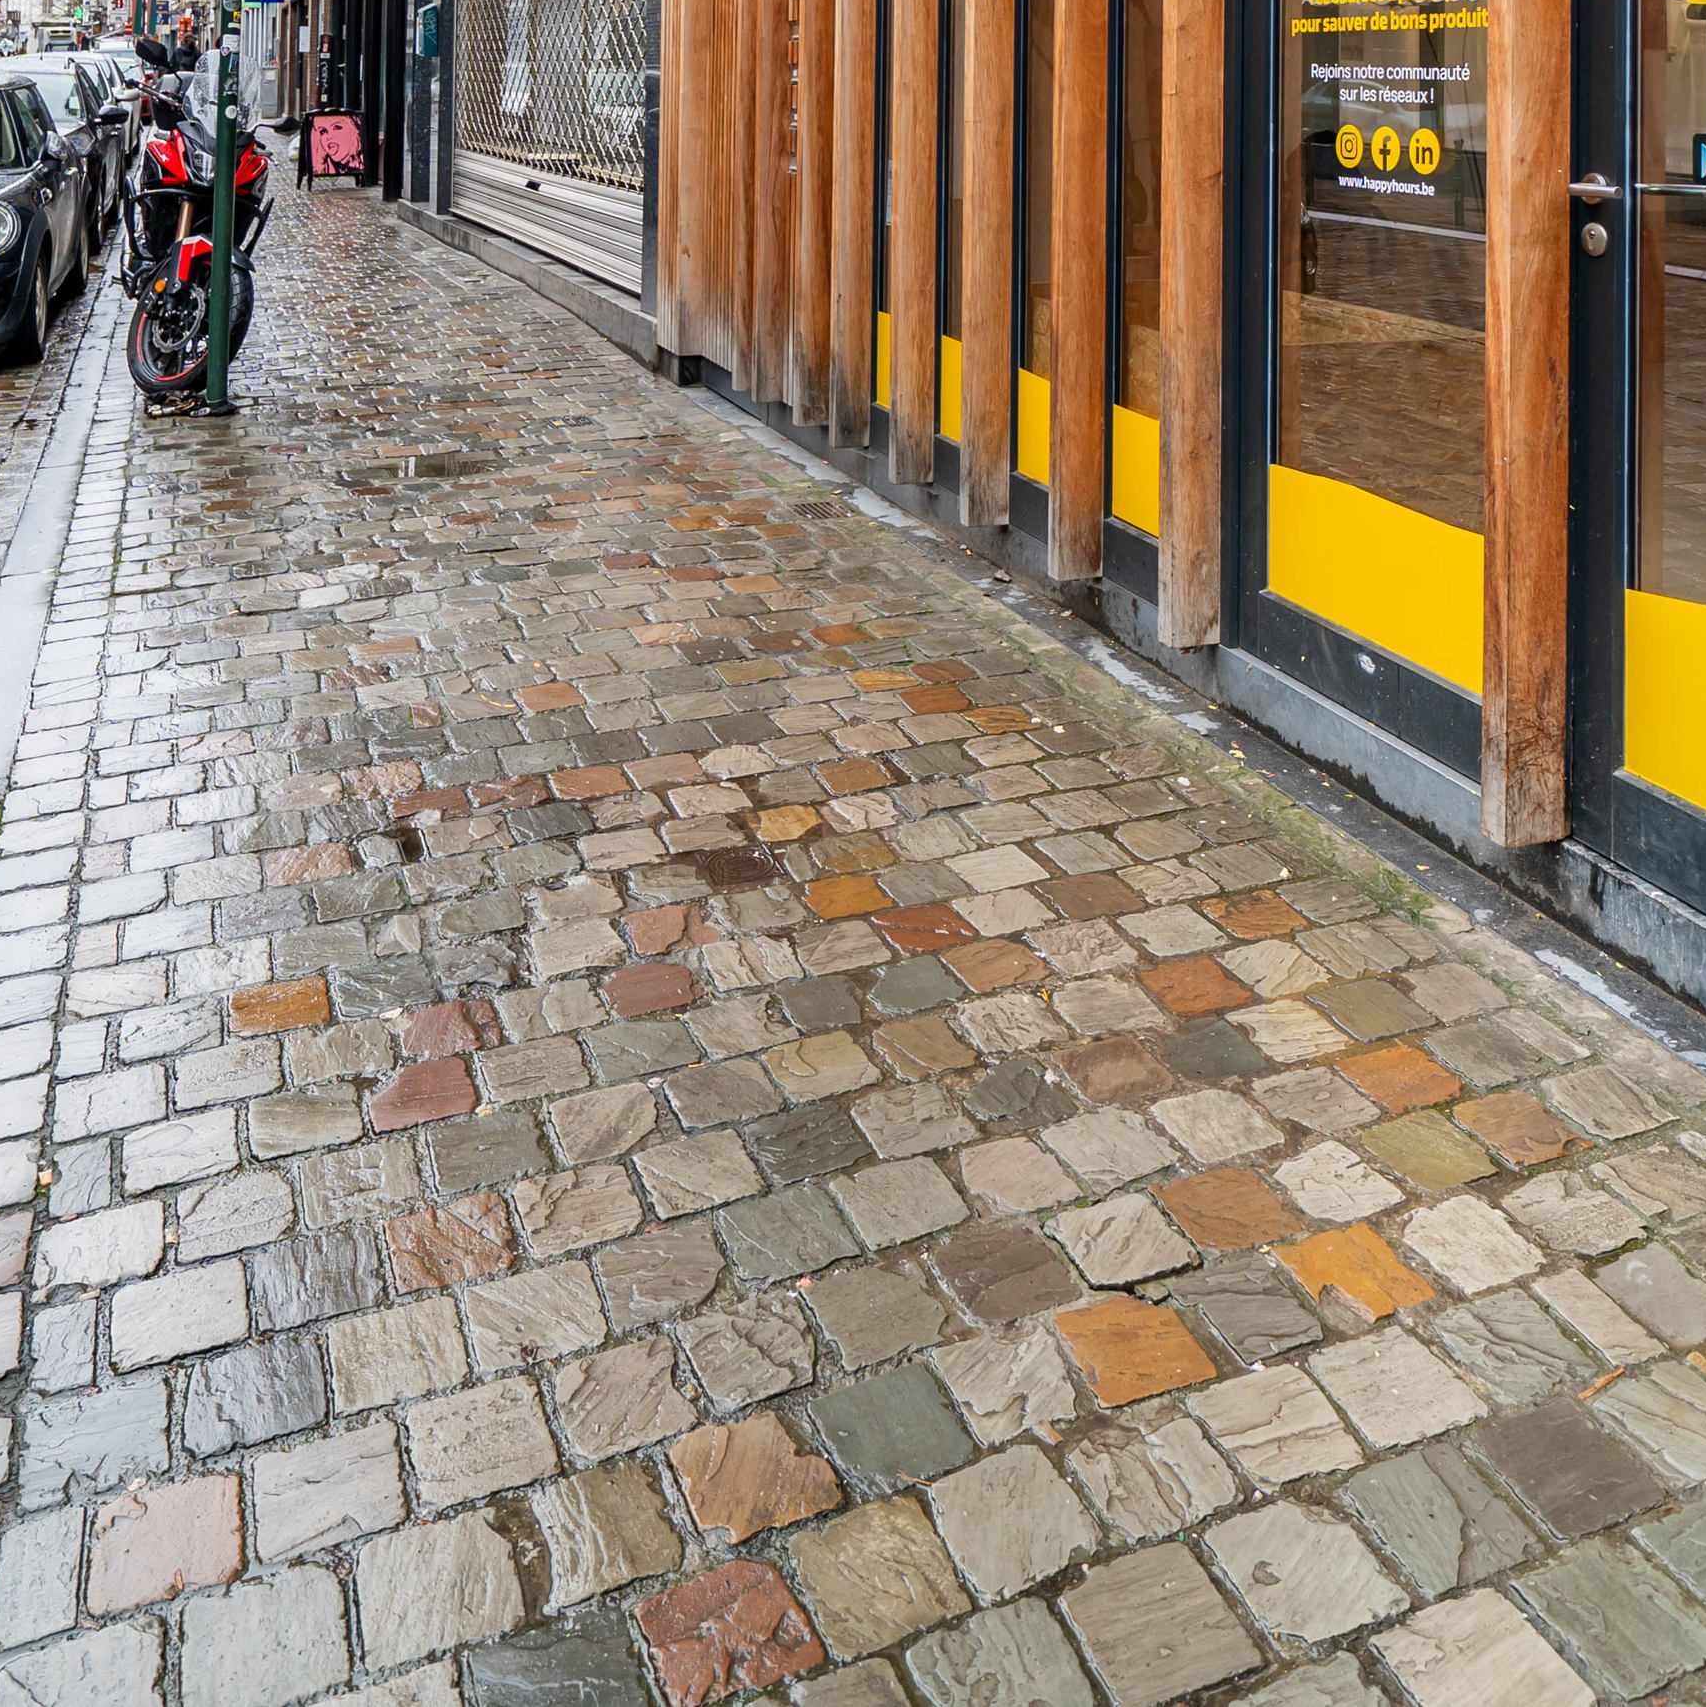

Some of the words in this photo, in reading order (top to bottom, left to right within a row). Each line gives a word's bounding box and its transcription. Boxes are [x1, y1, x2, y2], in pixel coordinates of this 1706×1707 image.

[1291, 17, 1322, 36] pour
[1322, 15, 1369, 32] sauver
[1370, 11, 1388, 31] de
[1390, 10, 1427, 31] bons
[1311, 63, 1352, 82] Rejoins
[1353, 66, 1385, 80] notre
[1386, 63, 1470, 81] communauté
[1339, 88, 1357, 101] sur
[1360, 86, 1378, 102] les
[1379, 86, 1428, 103] réseaux
[1338, 175, 1435, 196] www.happyhours.be
